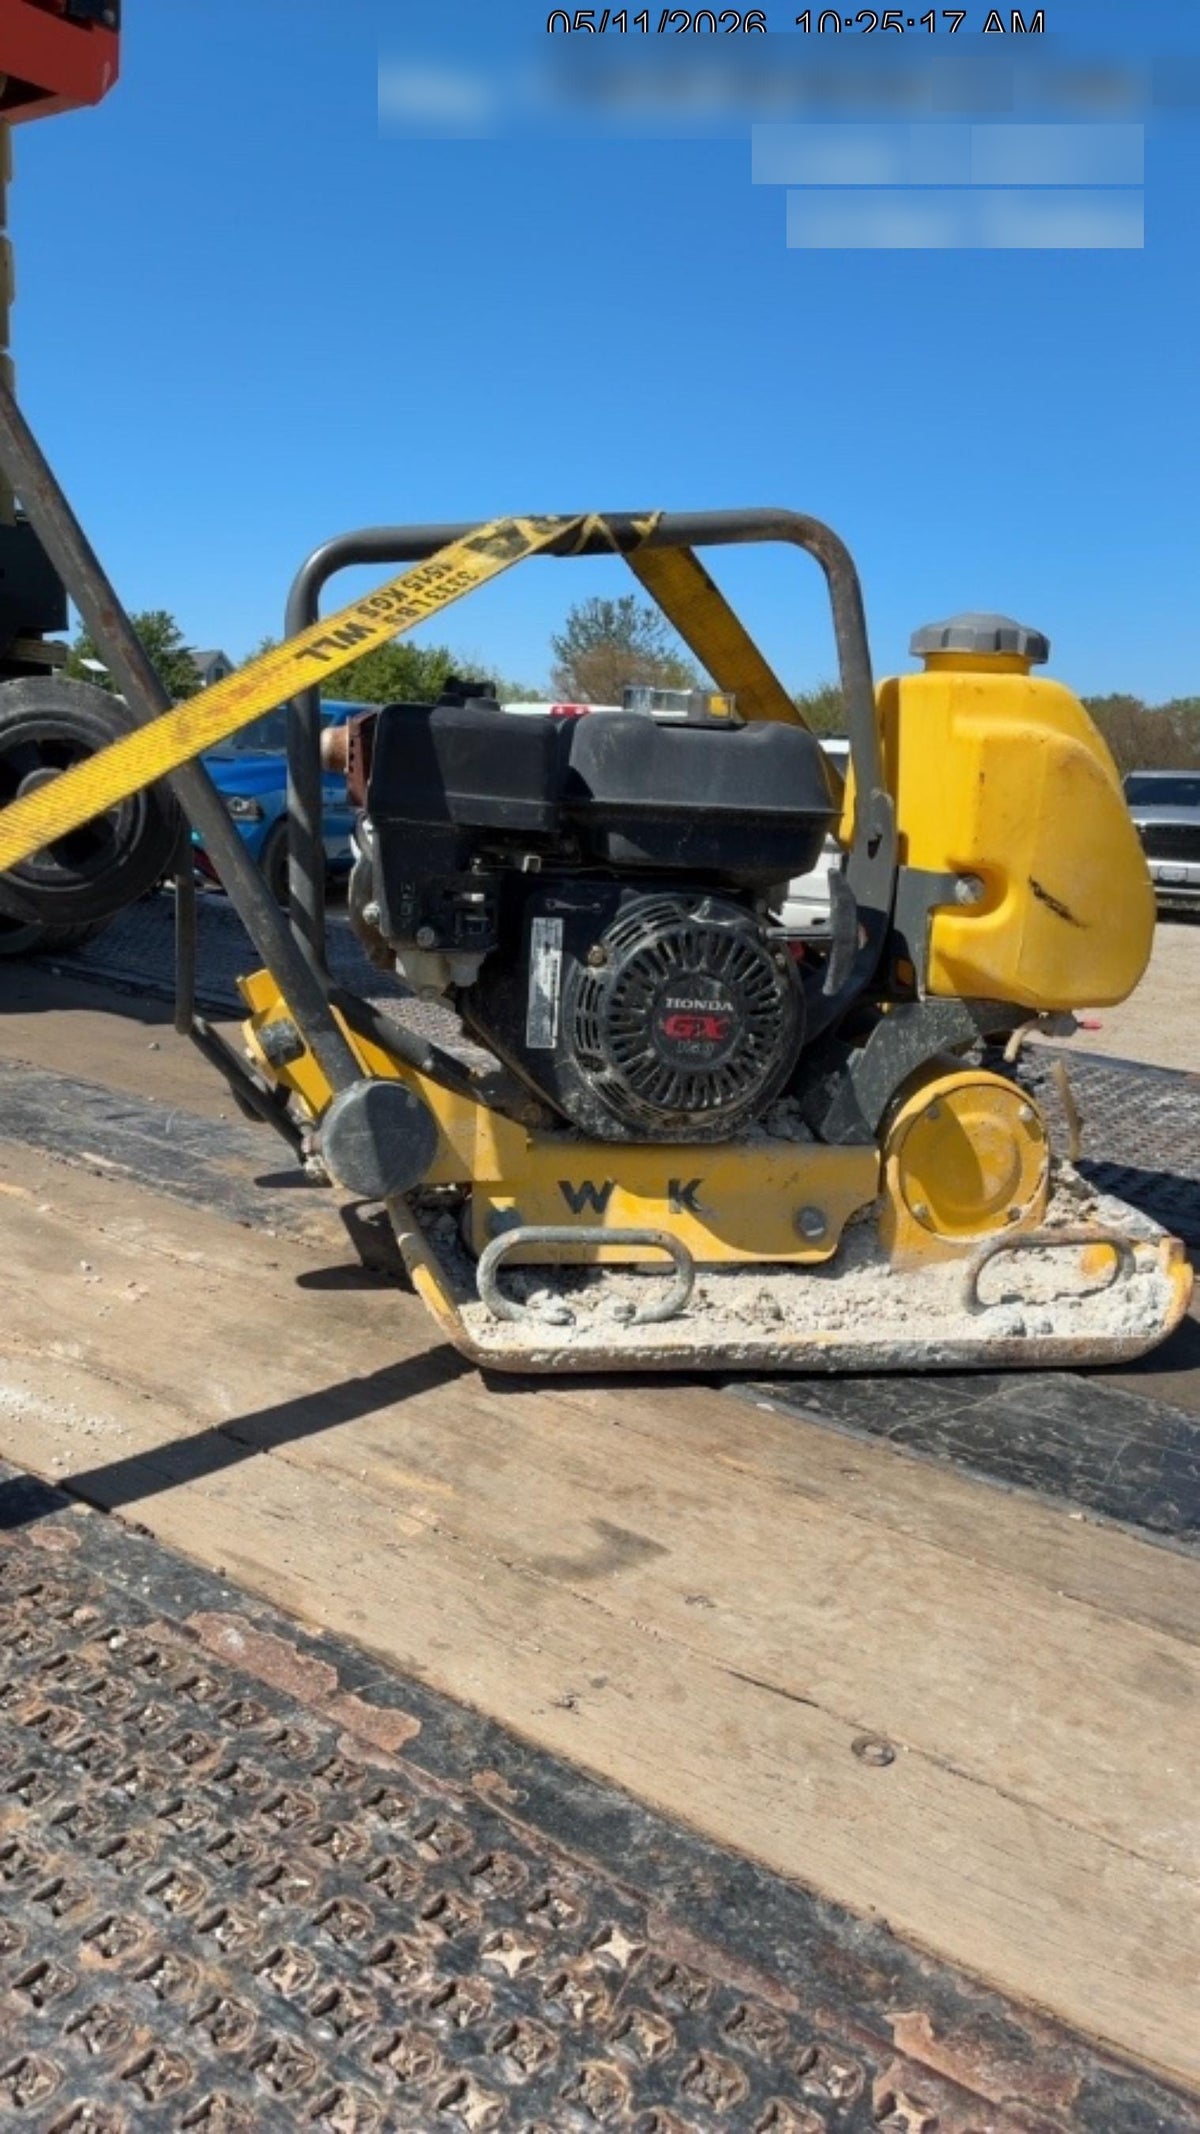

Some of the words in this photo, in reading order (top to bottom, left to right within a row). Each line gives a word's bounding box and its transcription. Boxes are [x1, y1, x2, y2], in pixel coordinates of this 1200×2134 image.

[425, 571, 479, 600] 3333
[294, 621, 377, 661] WLL
[665, 997, 734, 1012] HONDA
[662, 1014, 730, 1041] GX
